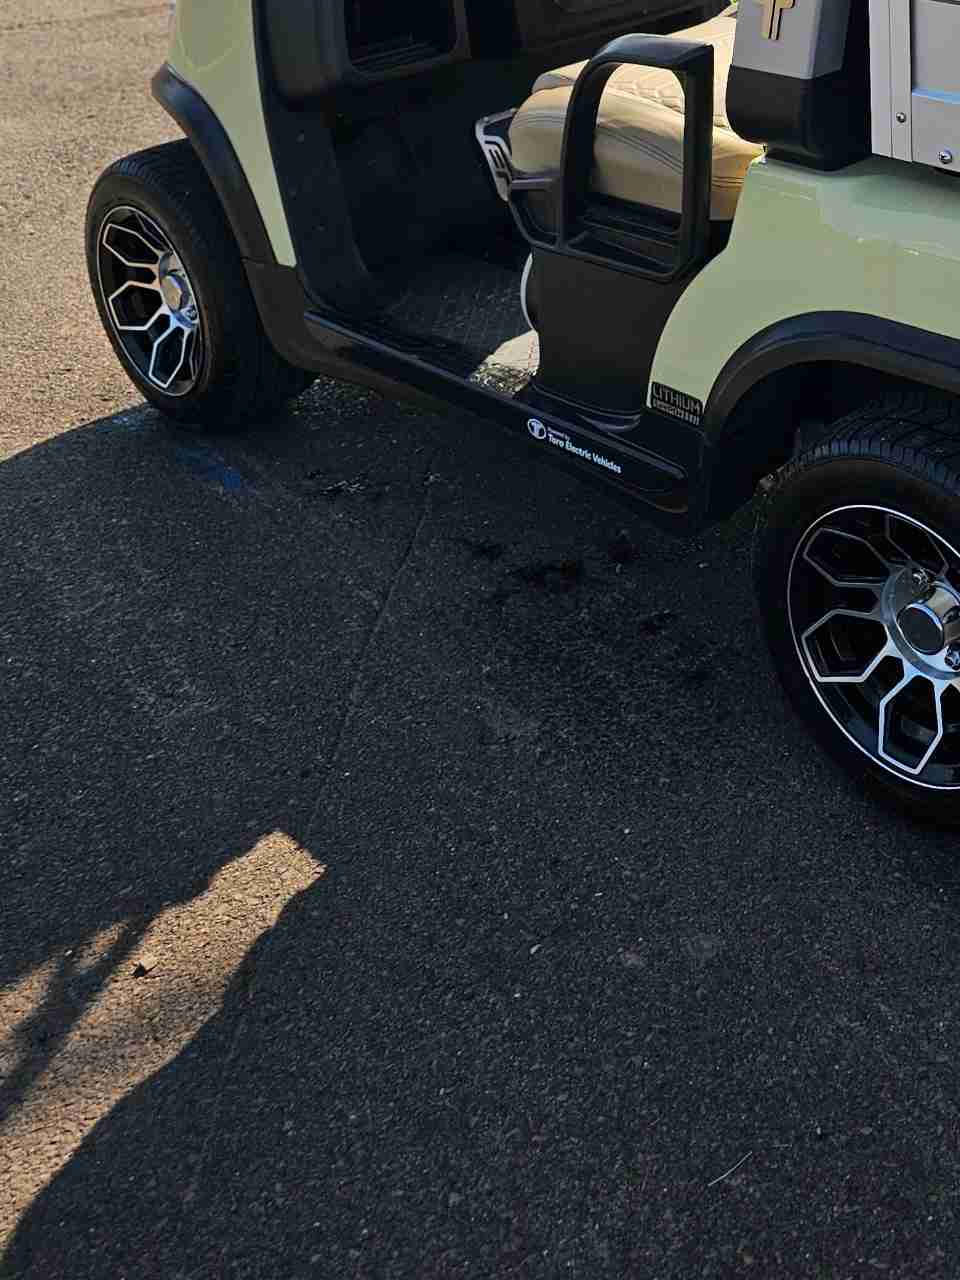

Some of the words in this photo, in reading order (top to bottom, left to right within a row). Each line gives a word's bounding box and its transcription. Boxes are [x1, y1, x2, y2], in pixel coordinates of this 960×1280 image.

[652, 383, 700, 416] LITHIUM
[565, 440, 592, 461] Electric
[592, 452, 622, 473] Vehicles
